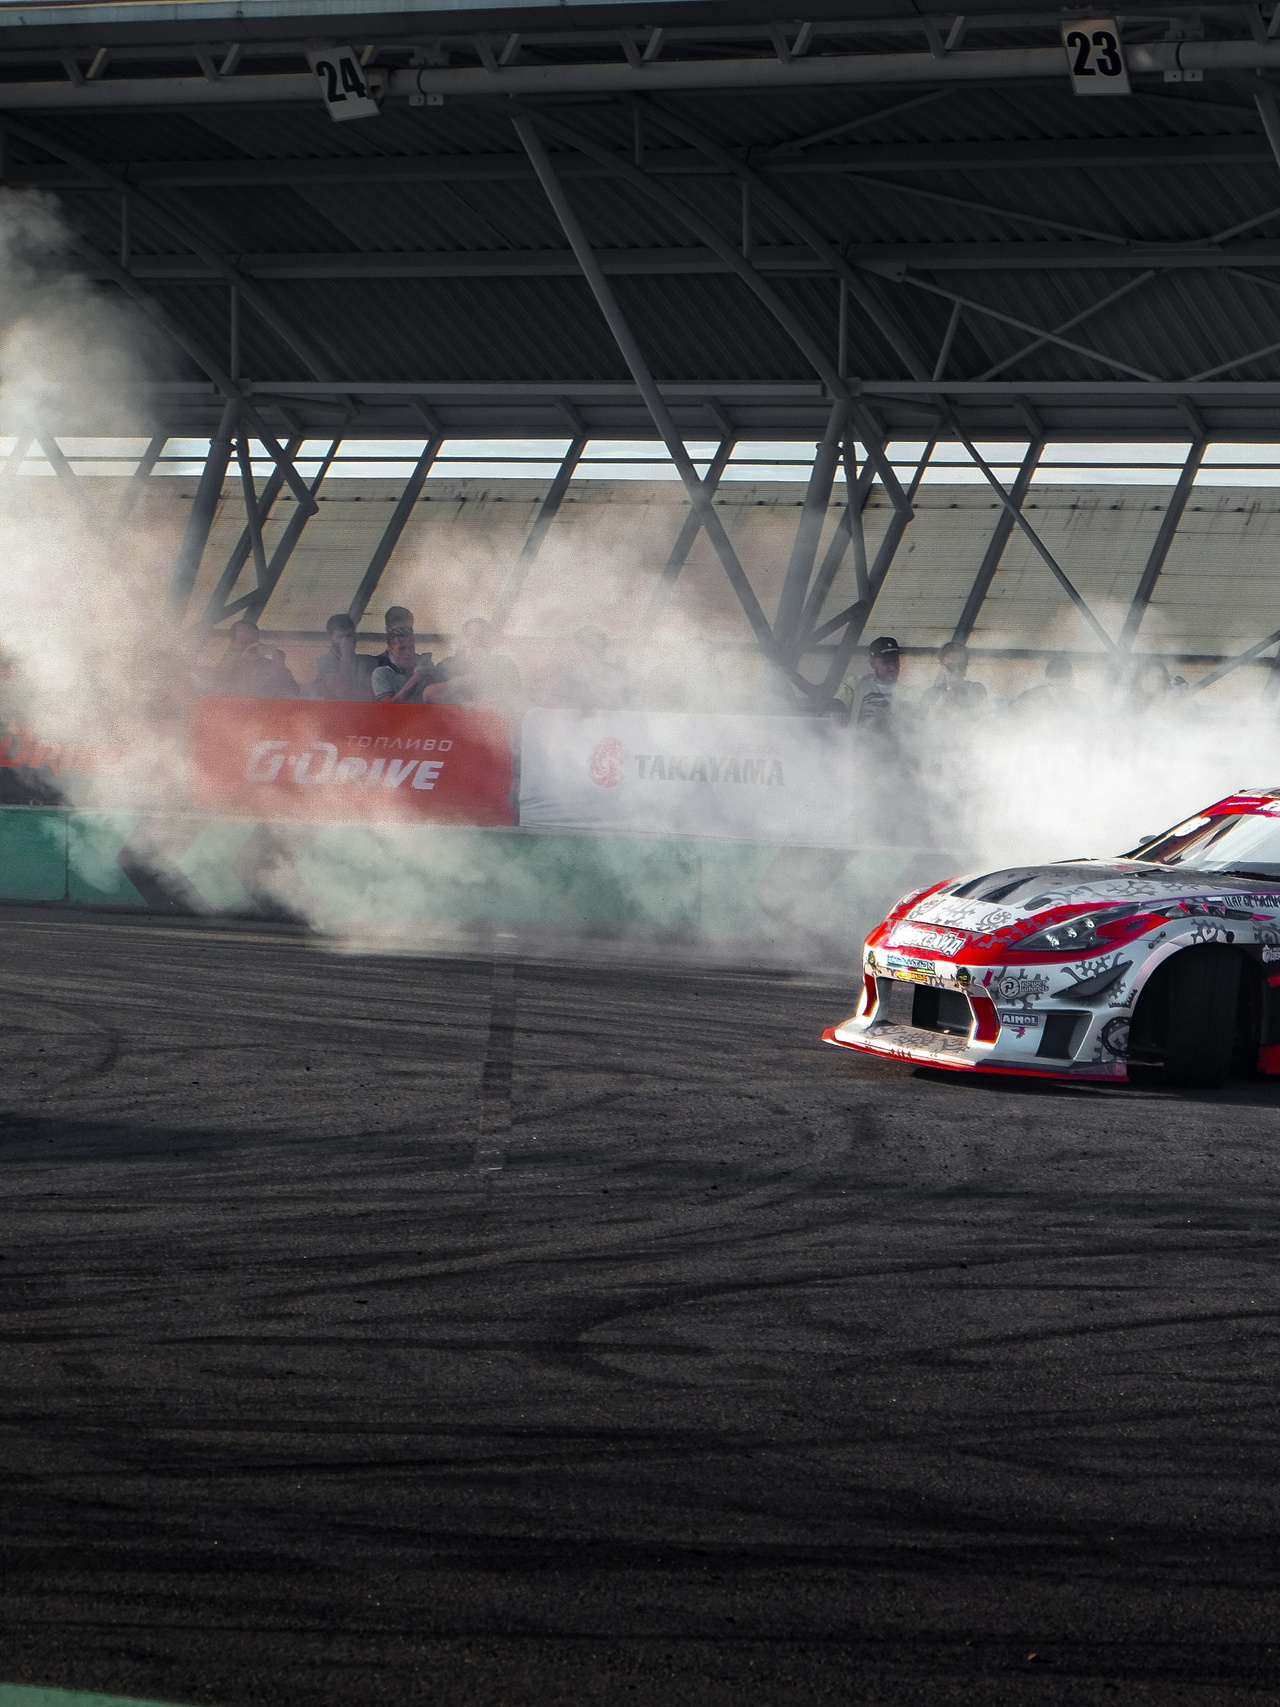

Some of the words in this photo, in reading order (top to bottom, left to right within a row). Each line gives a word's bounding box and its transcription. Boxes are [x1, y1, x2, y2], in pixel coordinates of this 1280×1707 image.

[1067, 31, 1122, 76] 23
[316, 58, 367, 103] 24
[346, 736, 453, 752] ТОПЛИВО
[634, 754, 785, 787] TAKAYAMA
[887, 924, 965, 956] РКСАЙД
